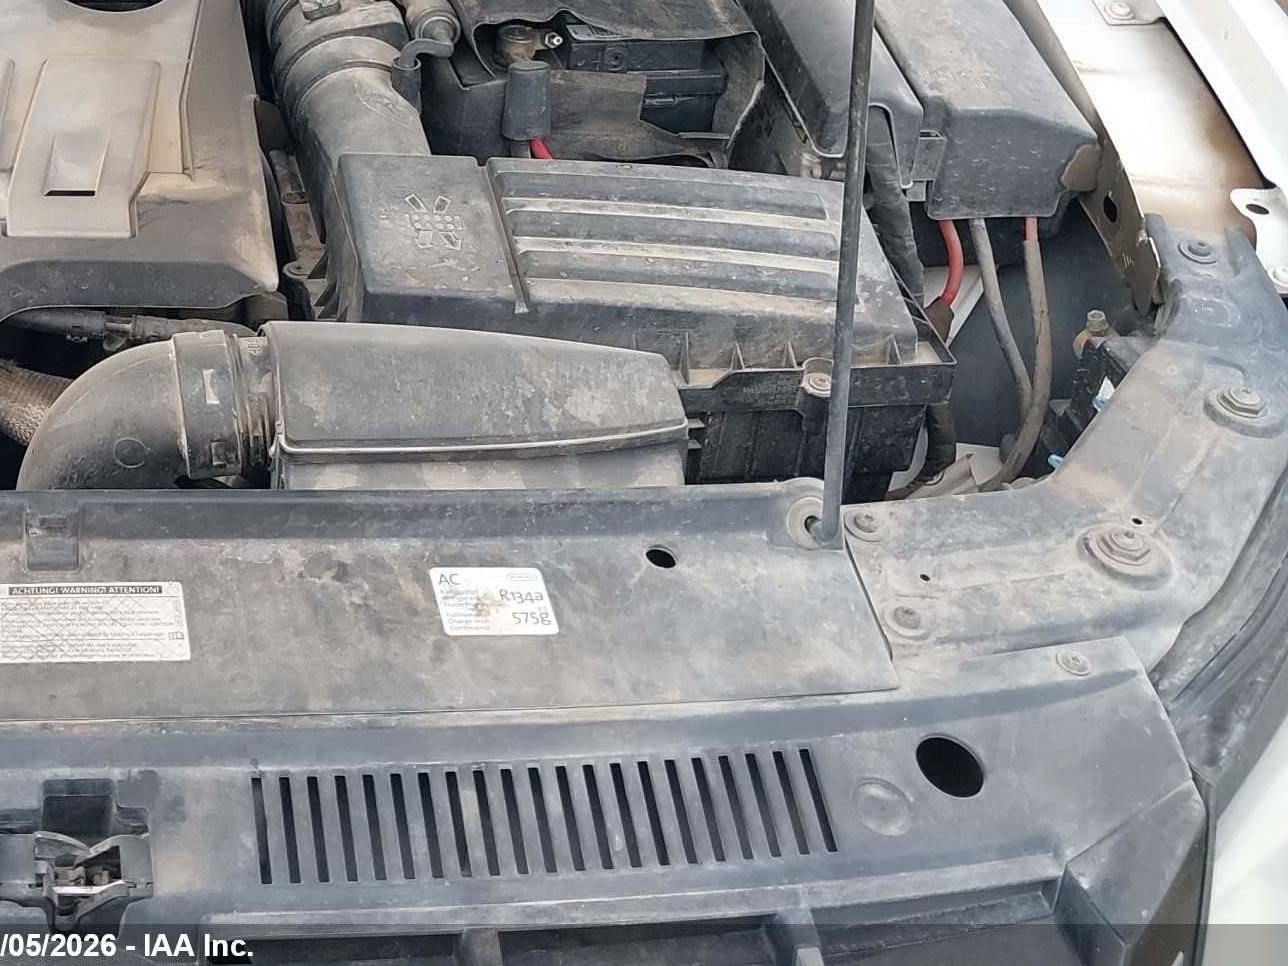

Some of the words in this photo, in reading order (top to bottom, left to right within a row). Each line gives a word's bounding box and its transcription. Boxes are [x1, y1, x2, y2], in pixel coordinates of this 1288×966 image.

[438, 573, 461, 585] AC
[11, 587, 58, 595] ACHTUNG!
[61, 586, 107, 594] WARNING!
[499, 589, 544, 604] R134a
[512, 612, 552, 625] 575g
